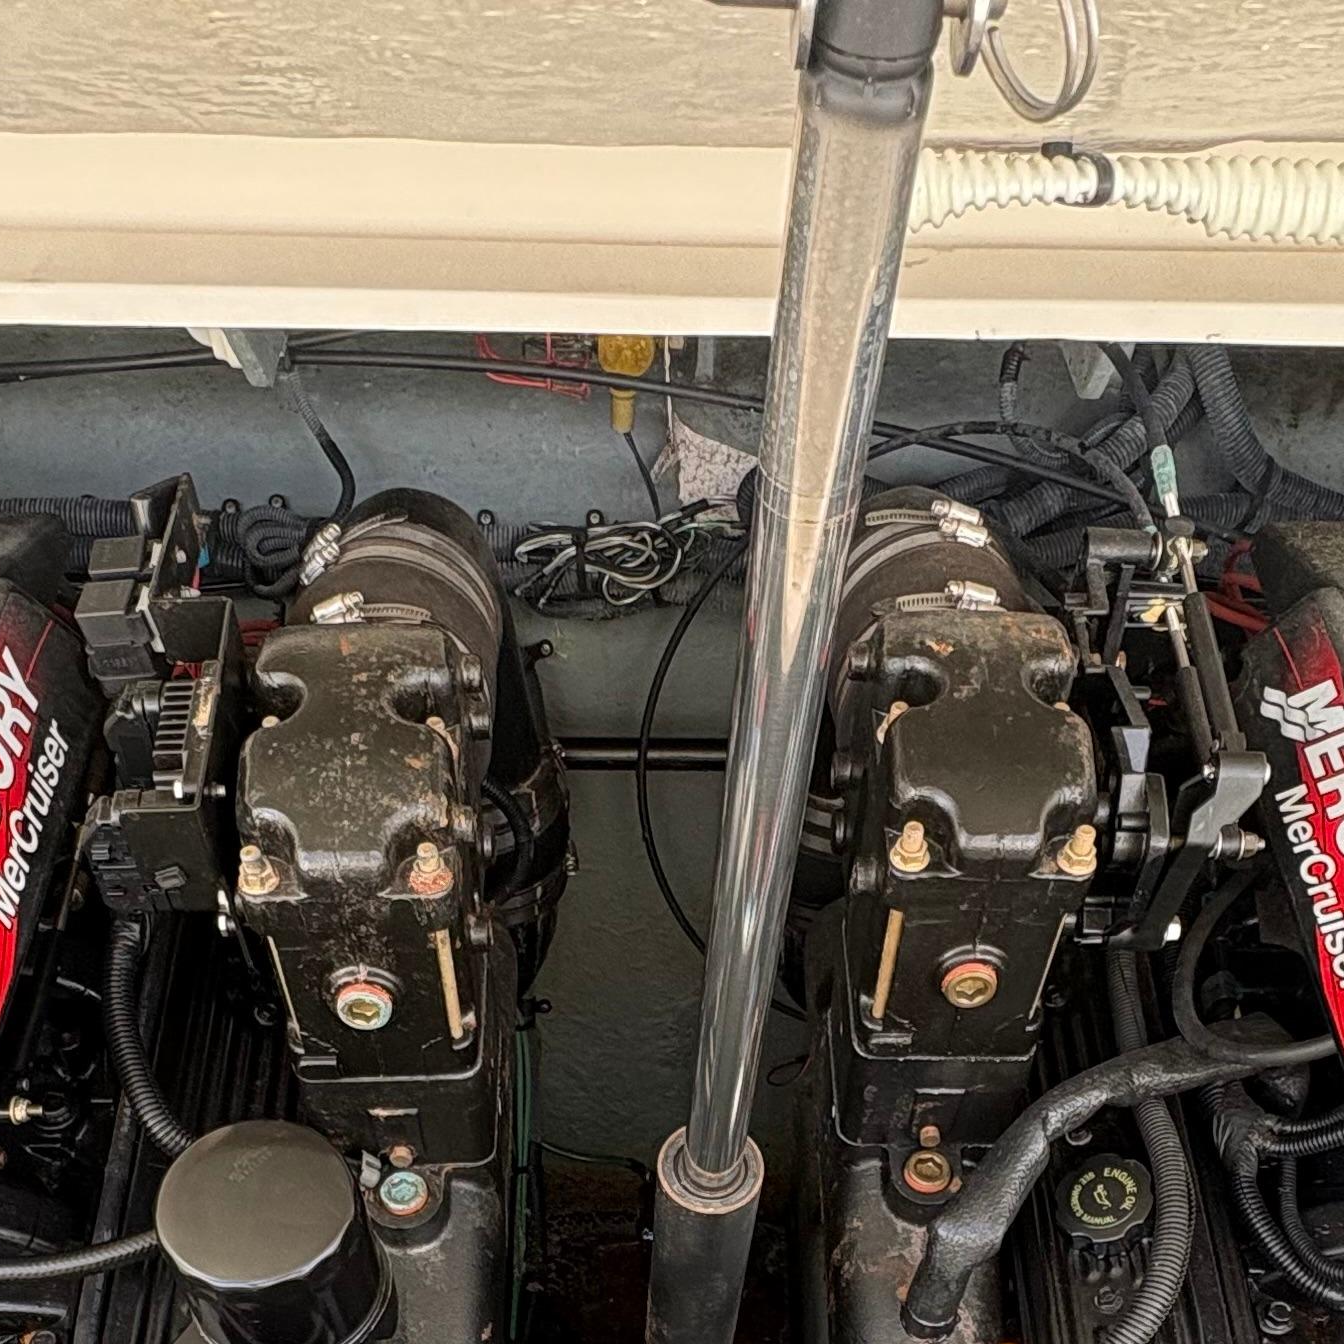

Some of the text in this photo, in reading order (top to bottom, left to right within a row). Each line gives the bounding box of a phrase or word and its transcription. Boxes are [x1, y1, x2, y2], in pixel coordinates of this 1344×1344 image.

[1103, 1167, 1137, 1211] ENGINE OIL
[1081, 1213, 1117, 1225] MANUAL
